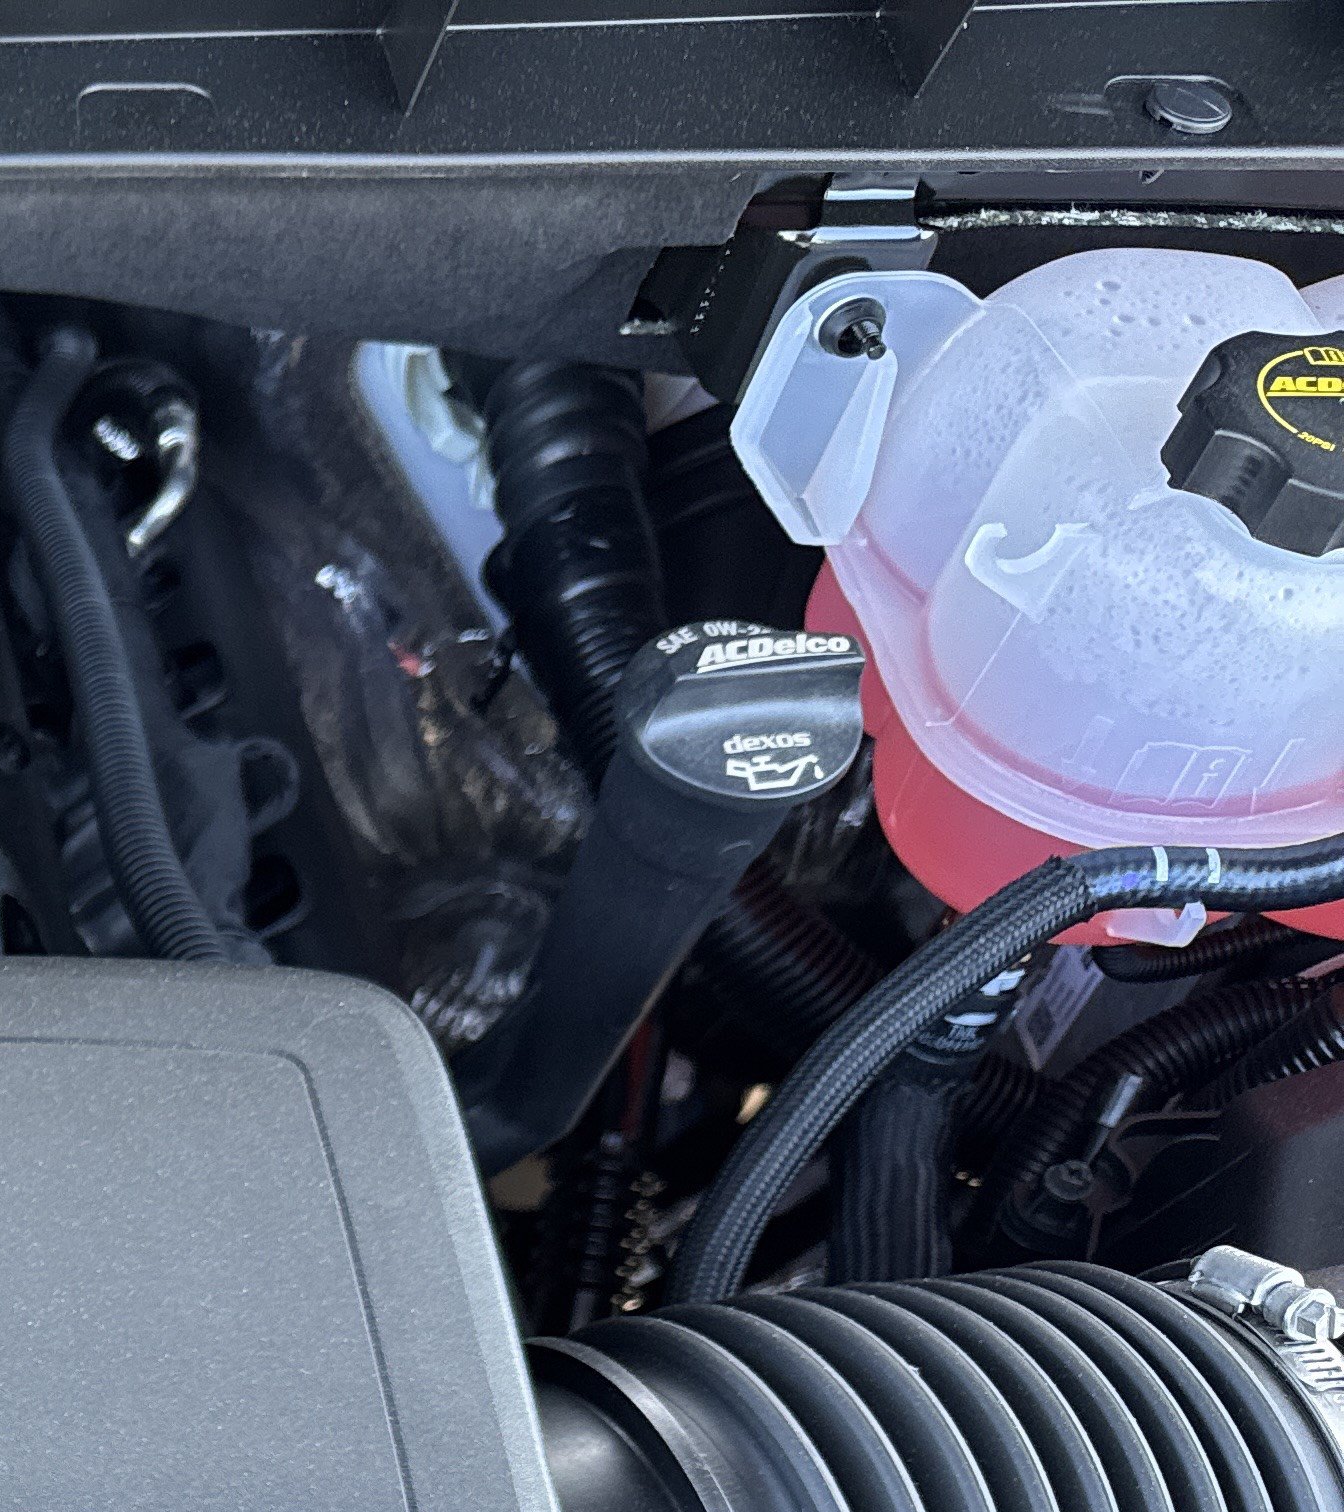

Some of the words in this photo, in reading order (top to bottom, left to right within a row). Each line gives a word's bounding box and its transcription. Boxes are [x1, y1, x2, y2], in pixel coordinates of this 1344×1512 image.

[1270, 376, 1344, 392] ACD
[1297, 431, 1336, 451] 20PSI
[656, 625, 698, 654] SAE
[696, 633, 851, 668] ACDelco
[722, 731, 811, 754] dexos
